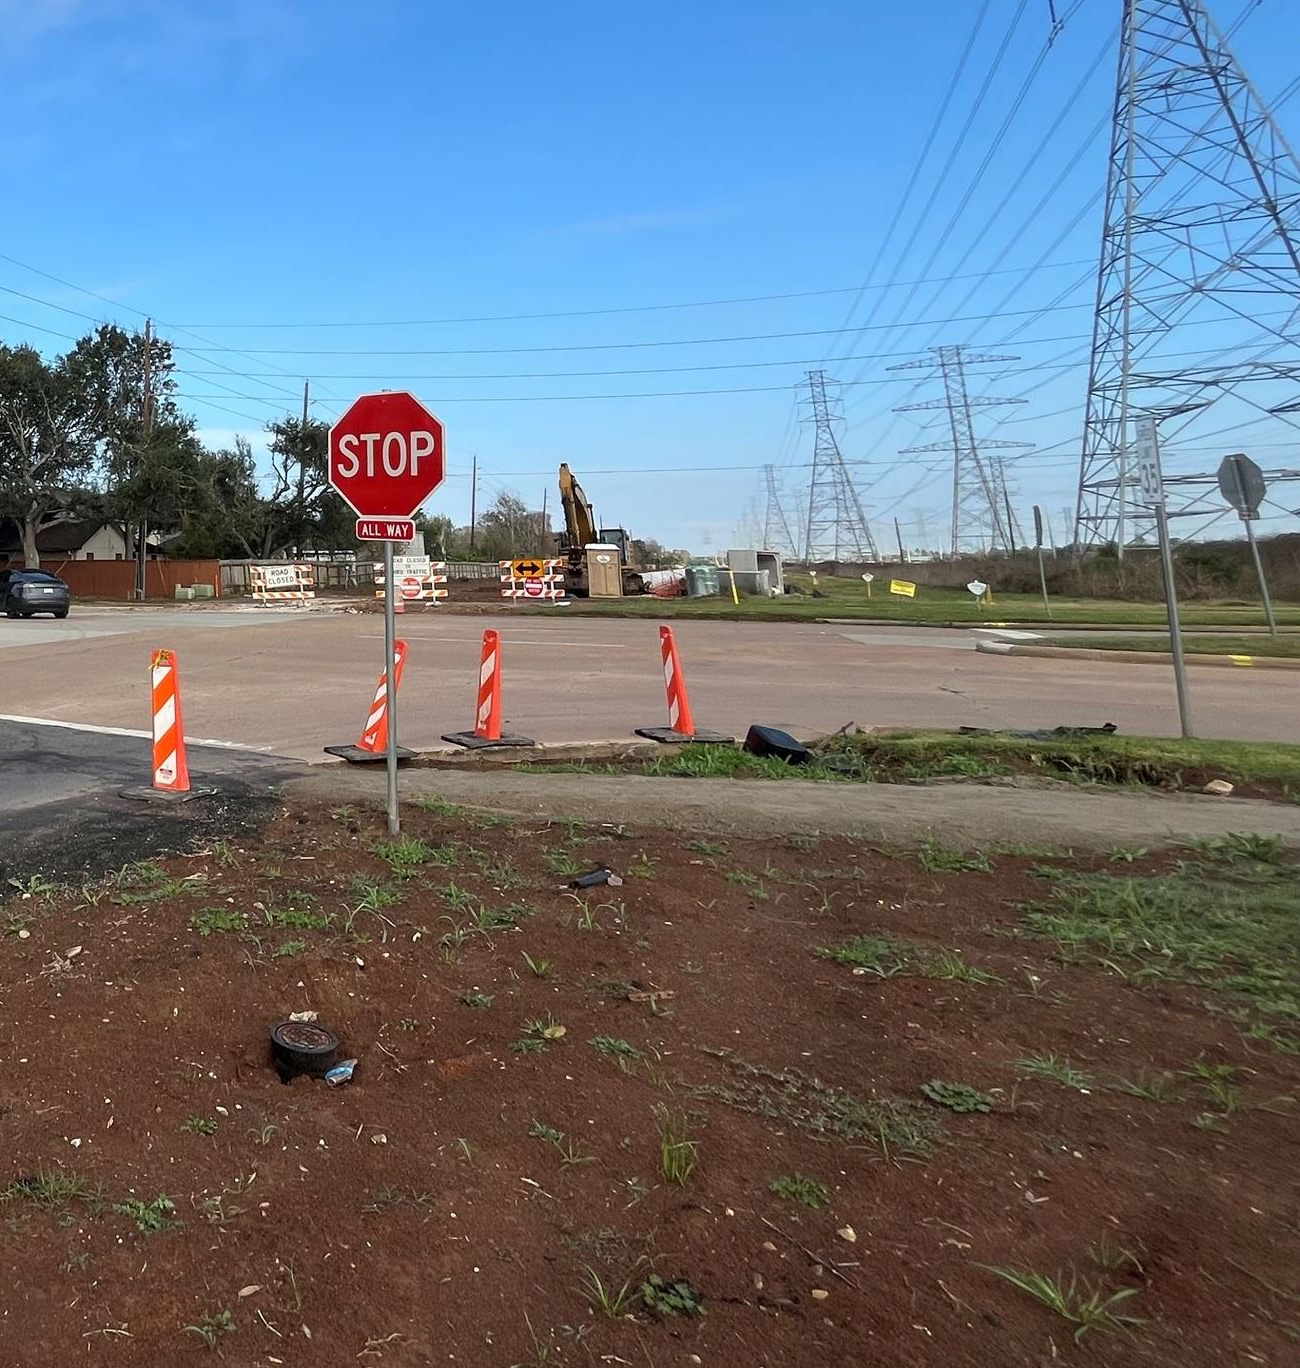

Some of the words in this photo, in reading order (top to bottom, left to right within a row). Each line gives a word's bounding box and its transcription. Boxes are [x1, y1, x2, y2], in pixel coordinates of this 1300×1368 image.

[337, 430, 435, 478] STOP
[361, 523, 381, 536] ALL
[386, 524, 409, 537] WAY
[270, 568, 289, 577] ROAD
[268, 576, 294, 585] CLOSED
